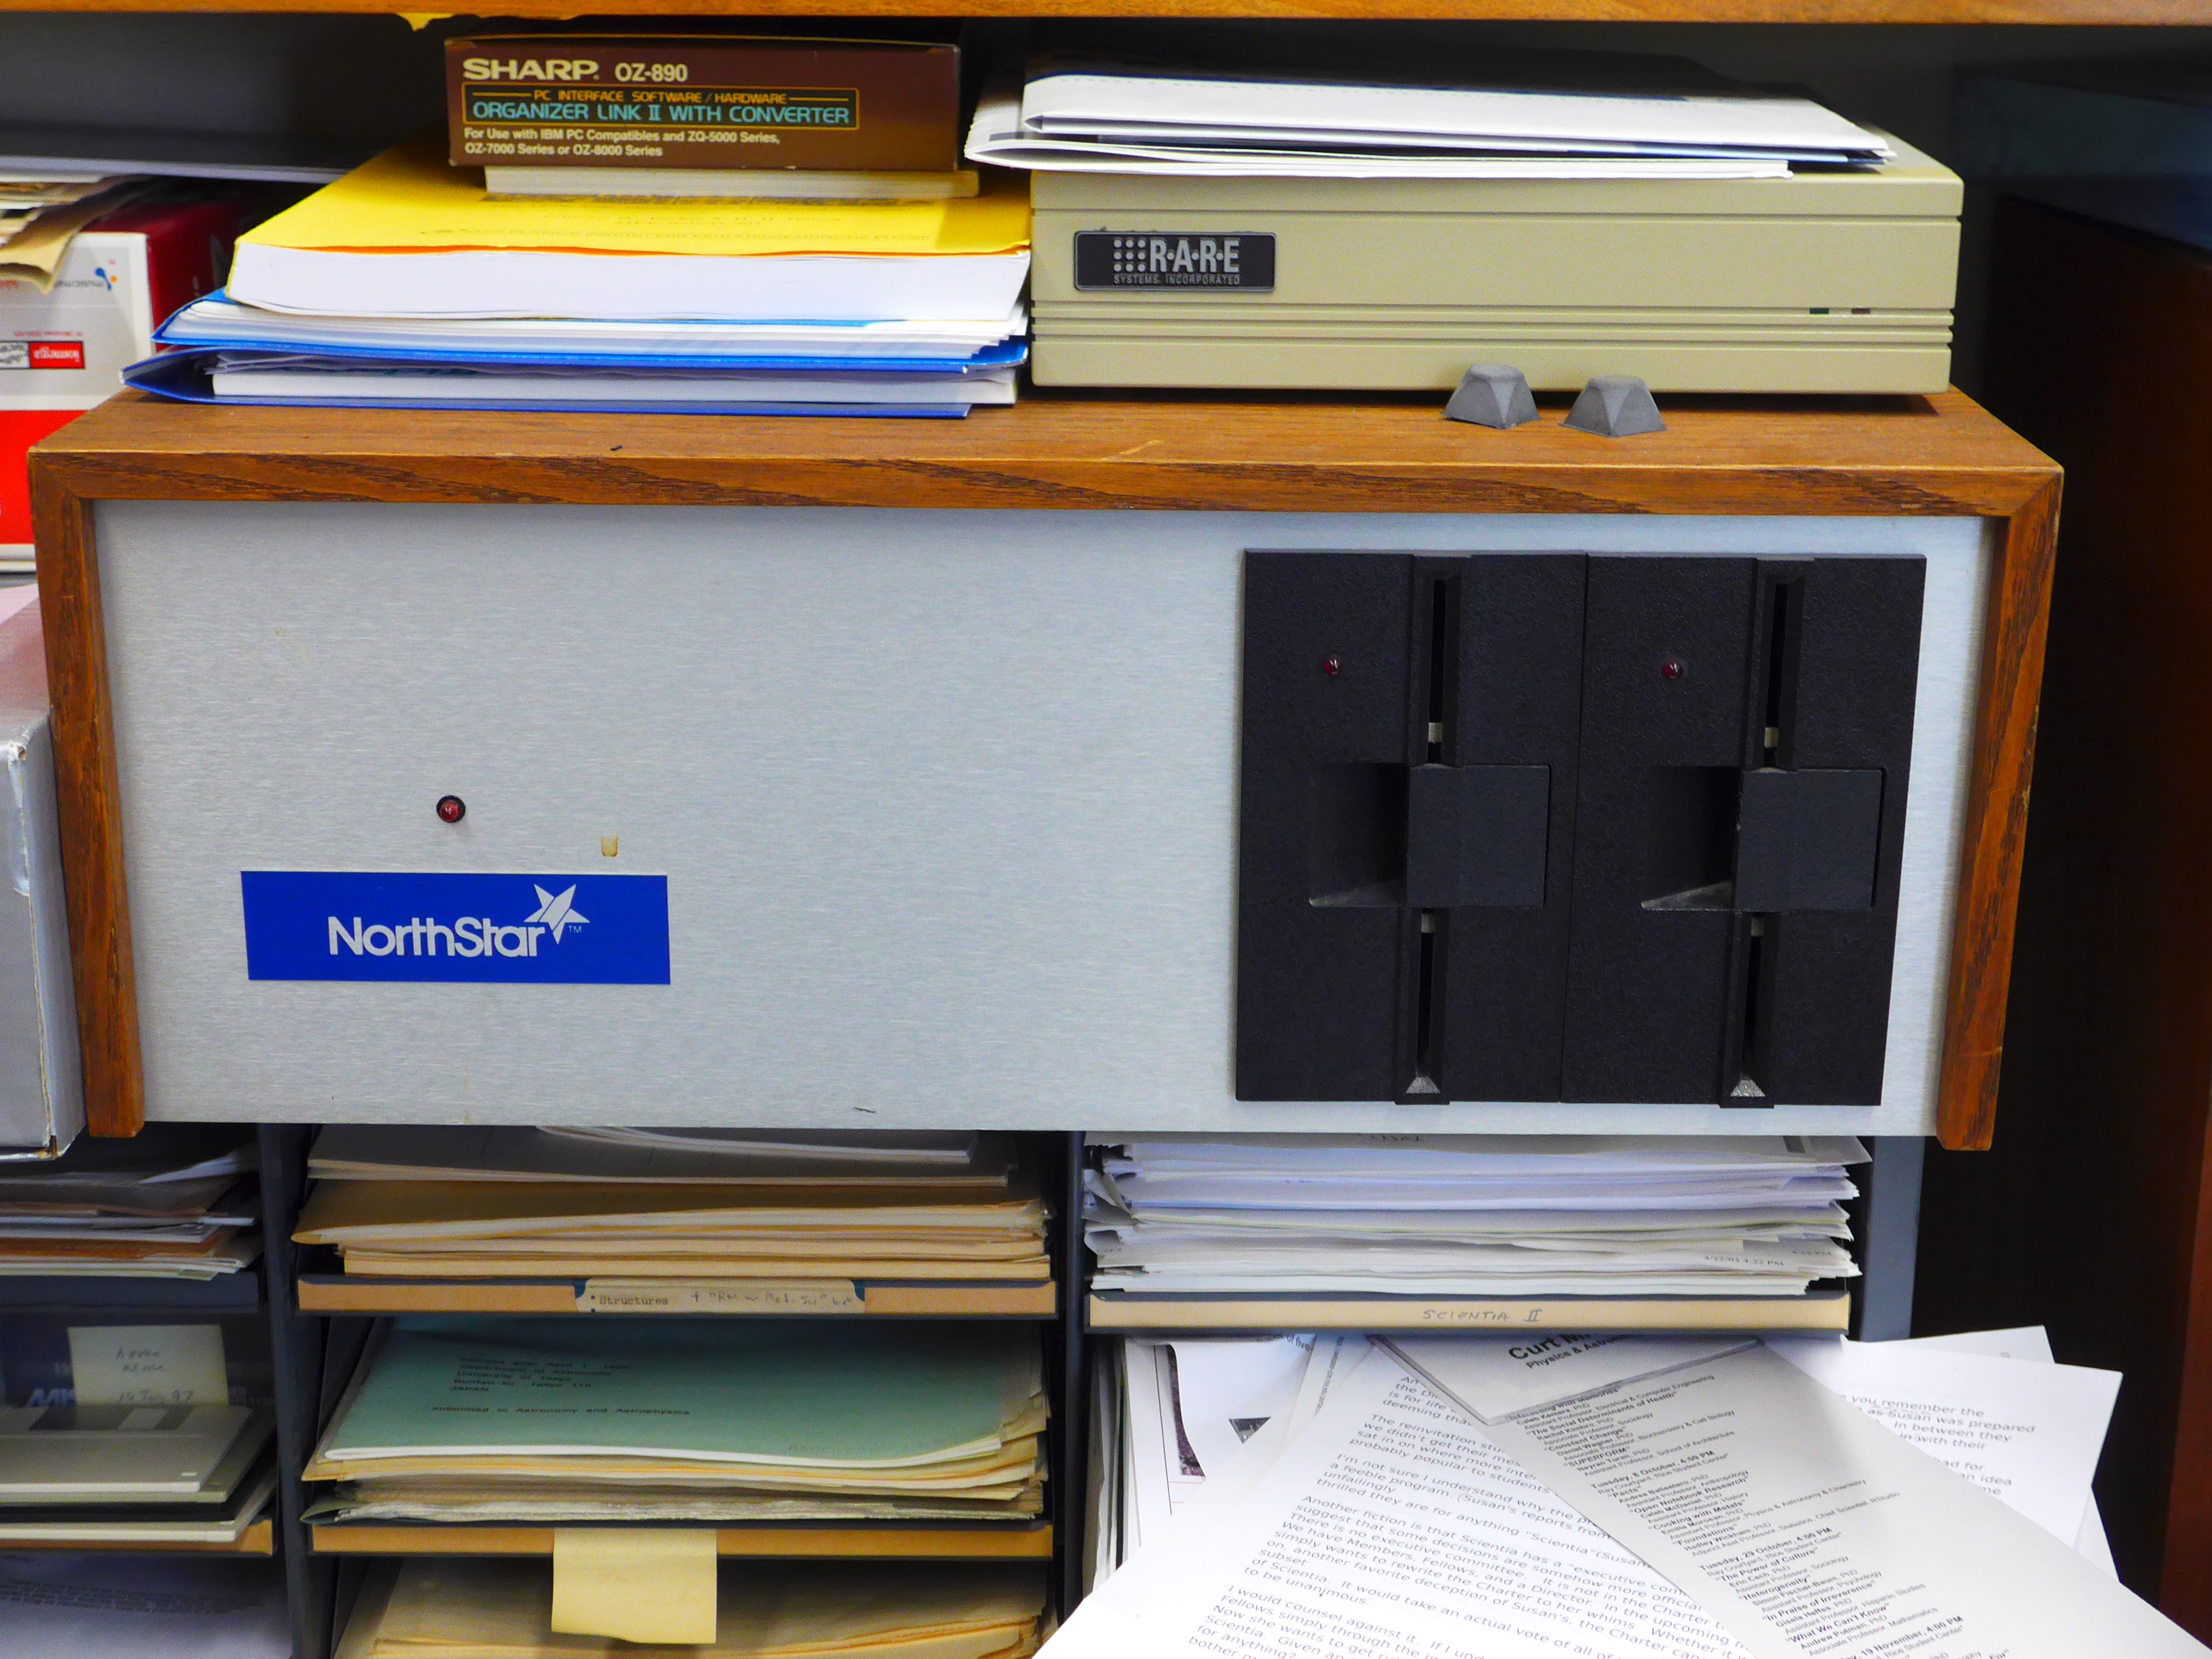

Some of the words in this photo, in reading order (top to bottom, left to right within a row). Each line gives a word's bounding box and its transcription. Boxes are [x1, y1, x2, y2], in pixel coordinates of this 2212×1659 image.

[463, 58, 599, 81] SHARP
[614, 62, 688, 82] OZ-890
[473, 102, 588, 120] ORGANIZER
[598, 104, 641, 121] LINK
[649, 105, 661, 121] II
[669, 106, 722, 122] WITH
[729, 106, 849, 124] CONVERTER
[534, 90, 551, 101] PC
[559, 90, 624, 102] INTERFACE
[632, 91, 702, 103] SOFTWARE
[714, 93, 787, 105] HARDWARE
[465, 128, 484, 139] For
[487, 128, 510, 139] Use
[513, 128, 538, 140] with
[541, 129, 564, 140] IBM
[566, 129, 583, 140] PC
[586, 129, 660, 143] Compatibles
[662, 131, 685, 142] and
[465, 142, 515, 154] OZ-7000
[517, 144, 555, 155] Series
[557, 145, 570, 155] or
[572, 144, 623, 156] OZ-8000
[625, 144, 663, 156] Series
[1166, 275, 1240, 285] INCORPORATED
[328, 916, 545, 957] NorthStar
[599, 1296, 669, 1306] Structures
[1509, 1336, 1562, 1359] Curt
[1526, 1350, 1571, 1370] Physics
[1851, 1395, 1877, 1406] you
[1882, 1399, 1957, 1413] remember
[1961, 1407, 1985, 1417] the
[1888, 1409, 1932, 1422] Susan
[1936, 1416, 1964, 1426] was
[1968, 1420, 2036, 1433] prepared
[1912, 1423, 1974, 1438] between
[1980, 1431, 2012, 1444] they
[1337, 1453, 1358, 1464] I'm
[1361, 1460, 1385, 1470] not
[1389, 1467, 1419, 1478] sure
[1432, 1478, 1513, 1503] understand
[1516, 1499, 1546, 1511] why
[1550, 1508, 1573, 1519] the
[1589, 1475, 1634, 1489] Tuesday,
[1639, 1462, 1680, 1475] October,
[1679, 1454, 1699, 1463] 4:00
[1629, 1504, 1658, 1513] "Open
[1659, 1490, 1703, 1506] Notebook
[1703, 1475, 1749, 1493] Research"
[1647, 1516, 1692, 1530] "Cooking
[1692, 1510, 1712, 1519] with
[1712, 1499, 1746, 1513] Metals"
[1301, 1495, 1360, 1514] Another
[1363, 1510, 1406, 1526] fiction
[1410, 1521, 1422, 1530] is
[1426, 1526, 1457, 1538] that
[1460, 1535, 1517, 1555] Scientia
[1522, 1551, 1548, 1563] has
[1568, 1563, 1646, 1587] "executive
[1672, 1523, 1737, 1546] "Foundations"
[1698, 1556, 1745, 1571] Tuesday,
[1755, 1540, 1797, 1553] October,
[1796, 1532, 1816, 1541] 4:00
[1815, 1527, 1832, 1536] PM
[1282, 1521, 1303, 1532] We
[1307, 1527, 1343, 1542] have
[1346, 1537, 1416, 1562] Members,
[1422, 1556, 1478, 1577] Fellows,
[1484, 1574, 1514, 1585] and
[1531, 1584, 1596, 1605] Director.
[1604, 1603, 1618, 1613] In
[1623, 1608, 1648, 1620] the
[1714, 1573, 1739, 1582] "The
[1739, 1563, 1768, 1576] Power
[1781, 1546, 1818, 1563] Culture"
[1273, 1531, 1321, 1548] simply
[1326, 1544, 1368, 1559] wants
[1371, 1555, 1387, 1564] to
[1390, 1561, 1442, 1578] rewrite
[1447, 1573, 1471, 1585] the
[1475, 1582, 1533, 1600] Charter
[1536, 1597, 1552, 1606] to
[1556, 1601, 1583, 1614] her
[1587, 1610, 1638, 1631] whims.
[1738, 1574, 1811, 1600] "Heterogeneity"
[1270, 1562, 1331, 1583] Scientia.
[1340, 1580, 1352, 1589] It
[1356, 1585, 1401, 1601] would
[1404, 1597, 1436, 1611] take
[1440, 1608, 1459, 1617] an
[1463, 1614, 1511, 1631] actual
[1516, 1627, 1549, 1642] vote
[1553, 1639, 1571, 1648] of
[1573, 1645, 1593, 1656] all
[1777, 1604, 1808, 1617] Praise
[1809, 1598, 1819, 1606] of
[1819, 1579, 1875, 1603] Irreverence"
[1220, 1594, 1274, 1615] Fellows
[1277, 1611, 1327, 1630] simply
[1331, 1625, 1390, 1648] through
[1395, 1644, 1420, 1658] the
[1238, 1588, 1282, 1605] would
[1285, 1601, 1343, 1621] counsel
[1345, 1618, 1401, 1639] against
[1405, 1633, 1418, 1645] it.
[1785, 1629, 1816, 1642] "What
[1815, 1624, 1833, 1633] We
[1833, 1614, 1860, 1627] Can't
[1859, 1602, 1890, 1618] Know"
[1872, 1630, 1927, 1652] November,
[1926, 1621, 1947, 1632] 4:00
[1945, 1615, 1963, 1625] PM
